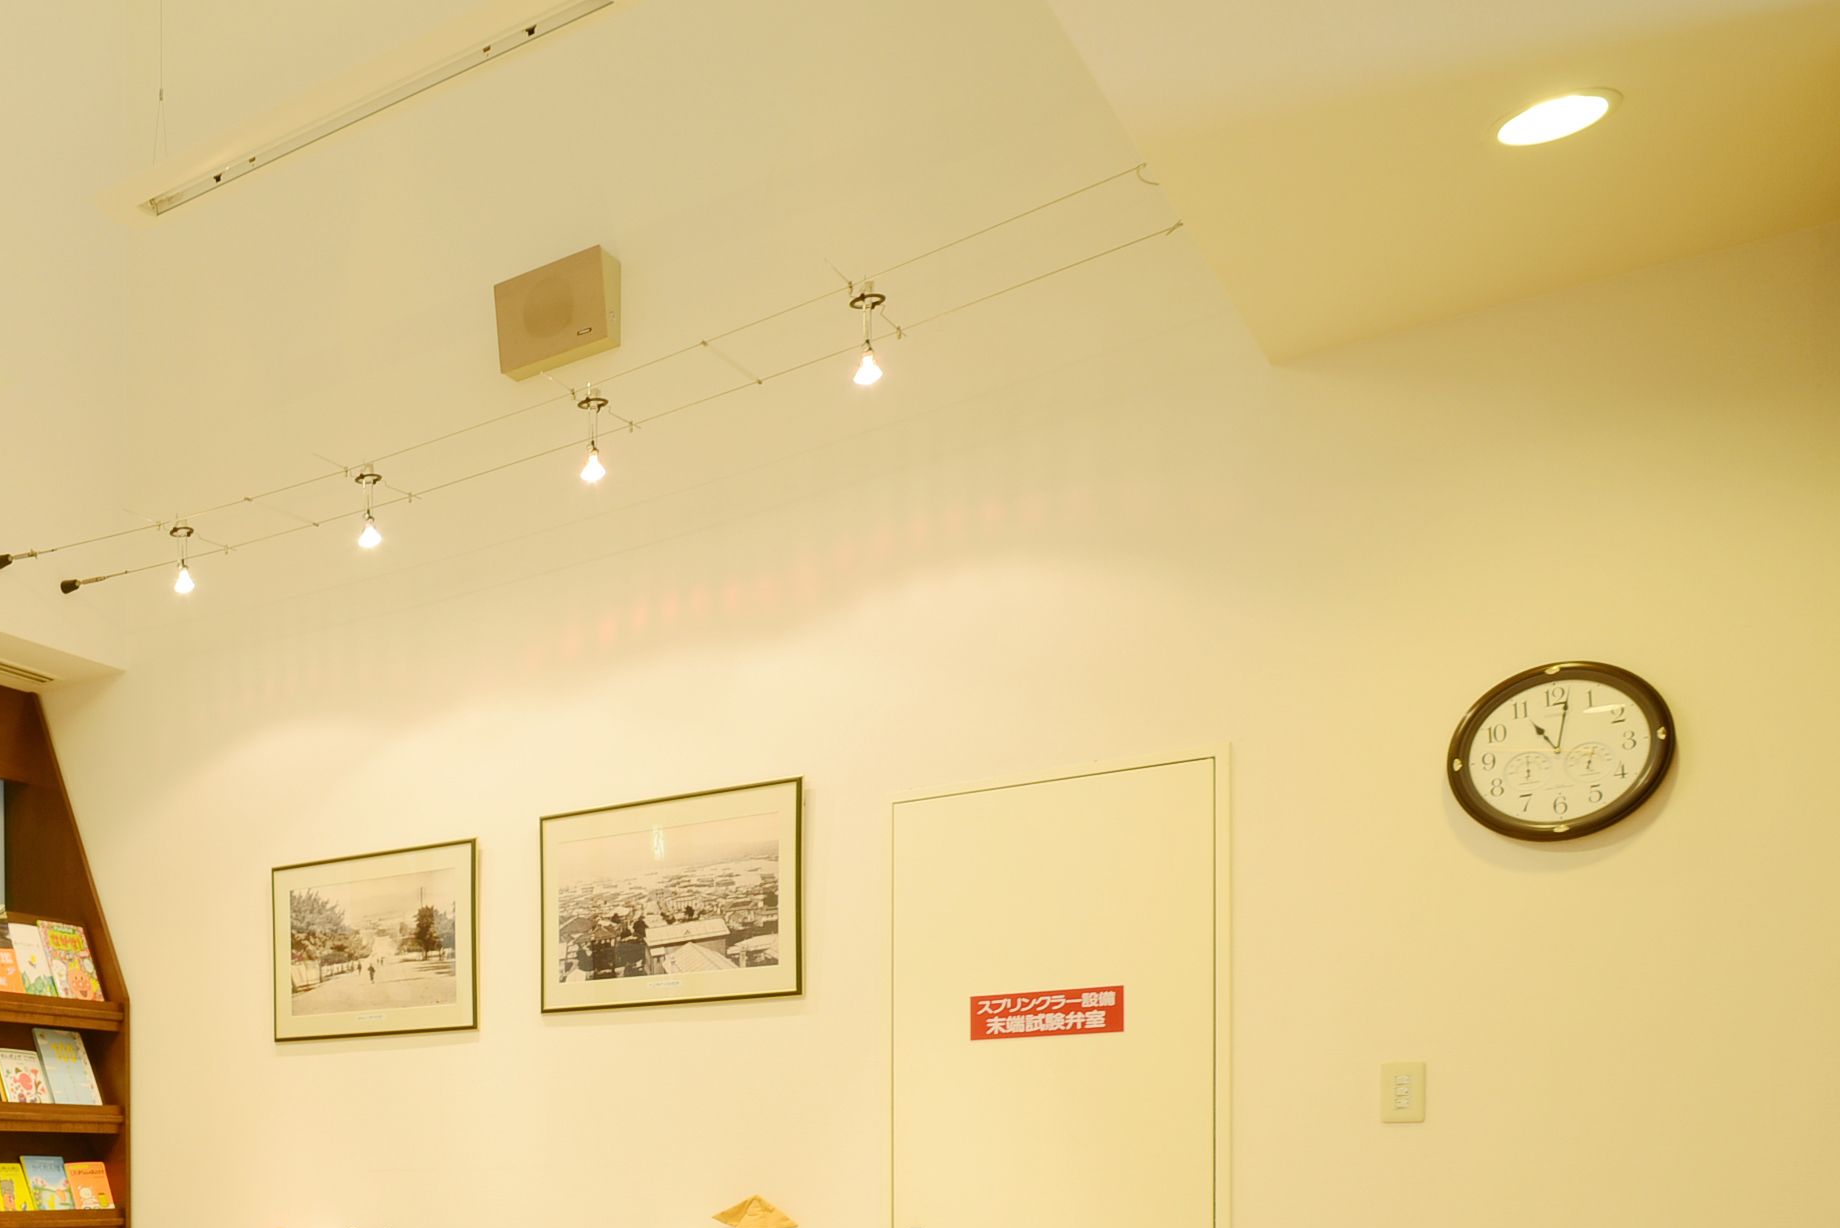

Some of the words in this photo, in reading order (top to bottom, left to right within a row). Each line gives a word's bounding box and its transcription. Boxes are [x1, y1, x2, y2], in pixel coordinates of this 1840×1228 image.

[1545, 687, 1567, 706] 12
[1586, 690, 1593, 708] 1
[1513, 701, 1529, 720] 11
[1611, 706, 1626, 724] 2
[1487, 724, 1507, 744] 10
[1622, 731, 1637, 750] 3
[1482, 753, 1496, 770] 9
[1614, 761, 1628, 779] 4
[1490, 779, 1505, 797] 8
[1588, 784, 1603, 803] 5
[1519, 794, 1533, 812] 7
[1553, 796, 1568, 814] 6
[977, 991, 1116, 1015] スプリンクラー設備
[986, 1010, 1106, 1035] 末端試験弁室
